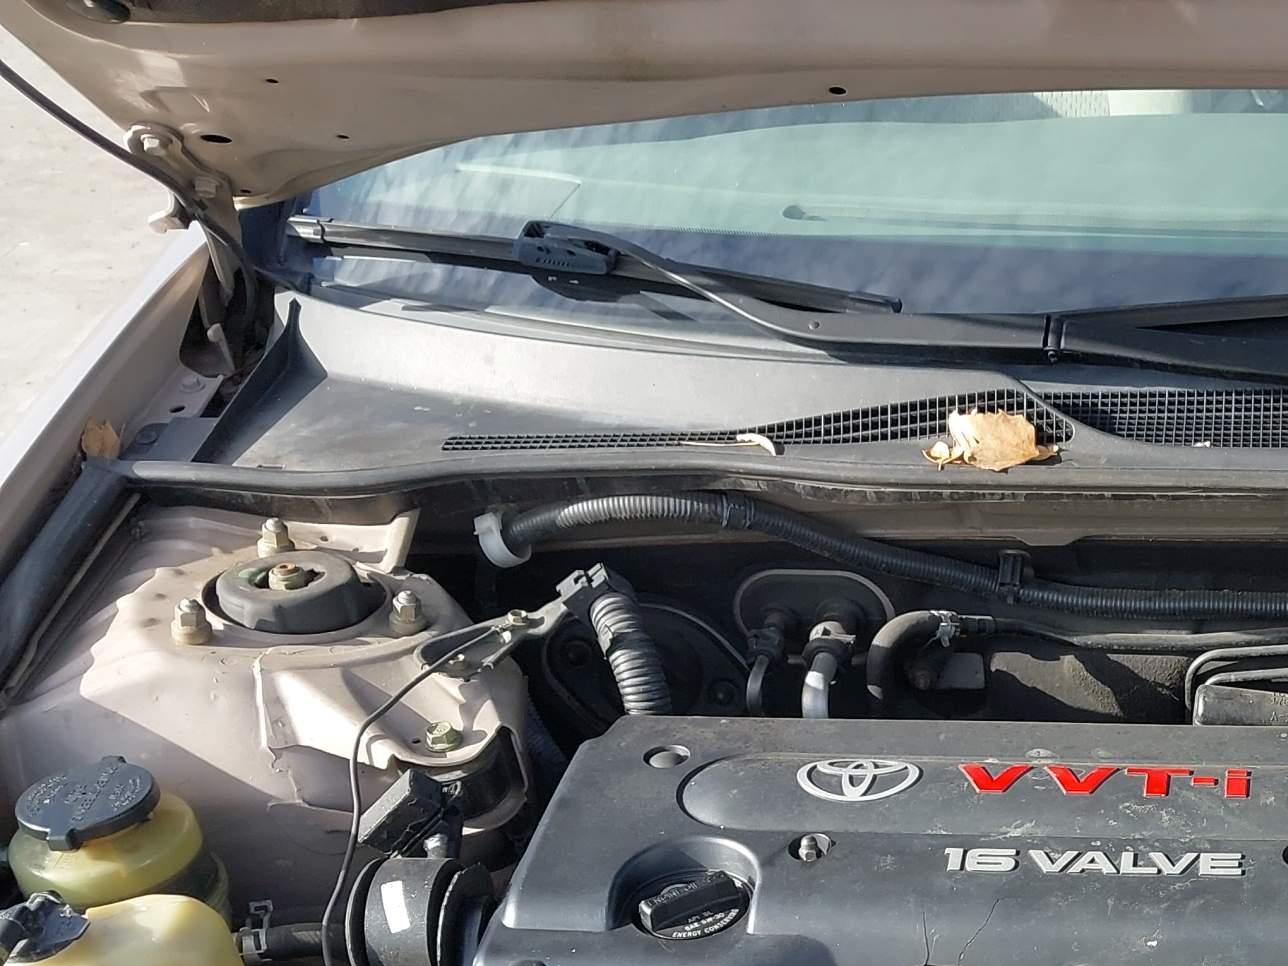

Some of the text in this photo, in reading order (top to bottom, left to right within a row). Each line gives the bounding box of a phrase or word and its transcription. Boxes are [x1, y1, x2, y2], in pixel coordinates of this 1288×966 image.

[959, 761, 1252, 799] VVT-i
[945, 846, 1245, 877] 16 VALVE
[684, 922, 701, 932] SAE
